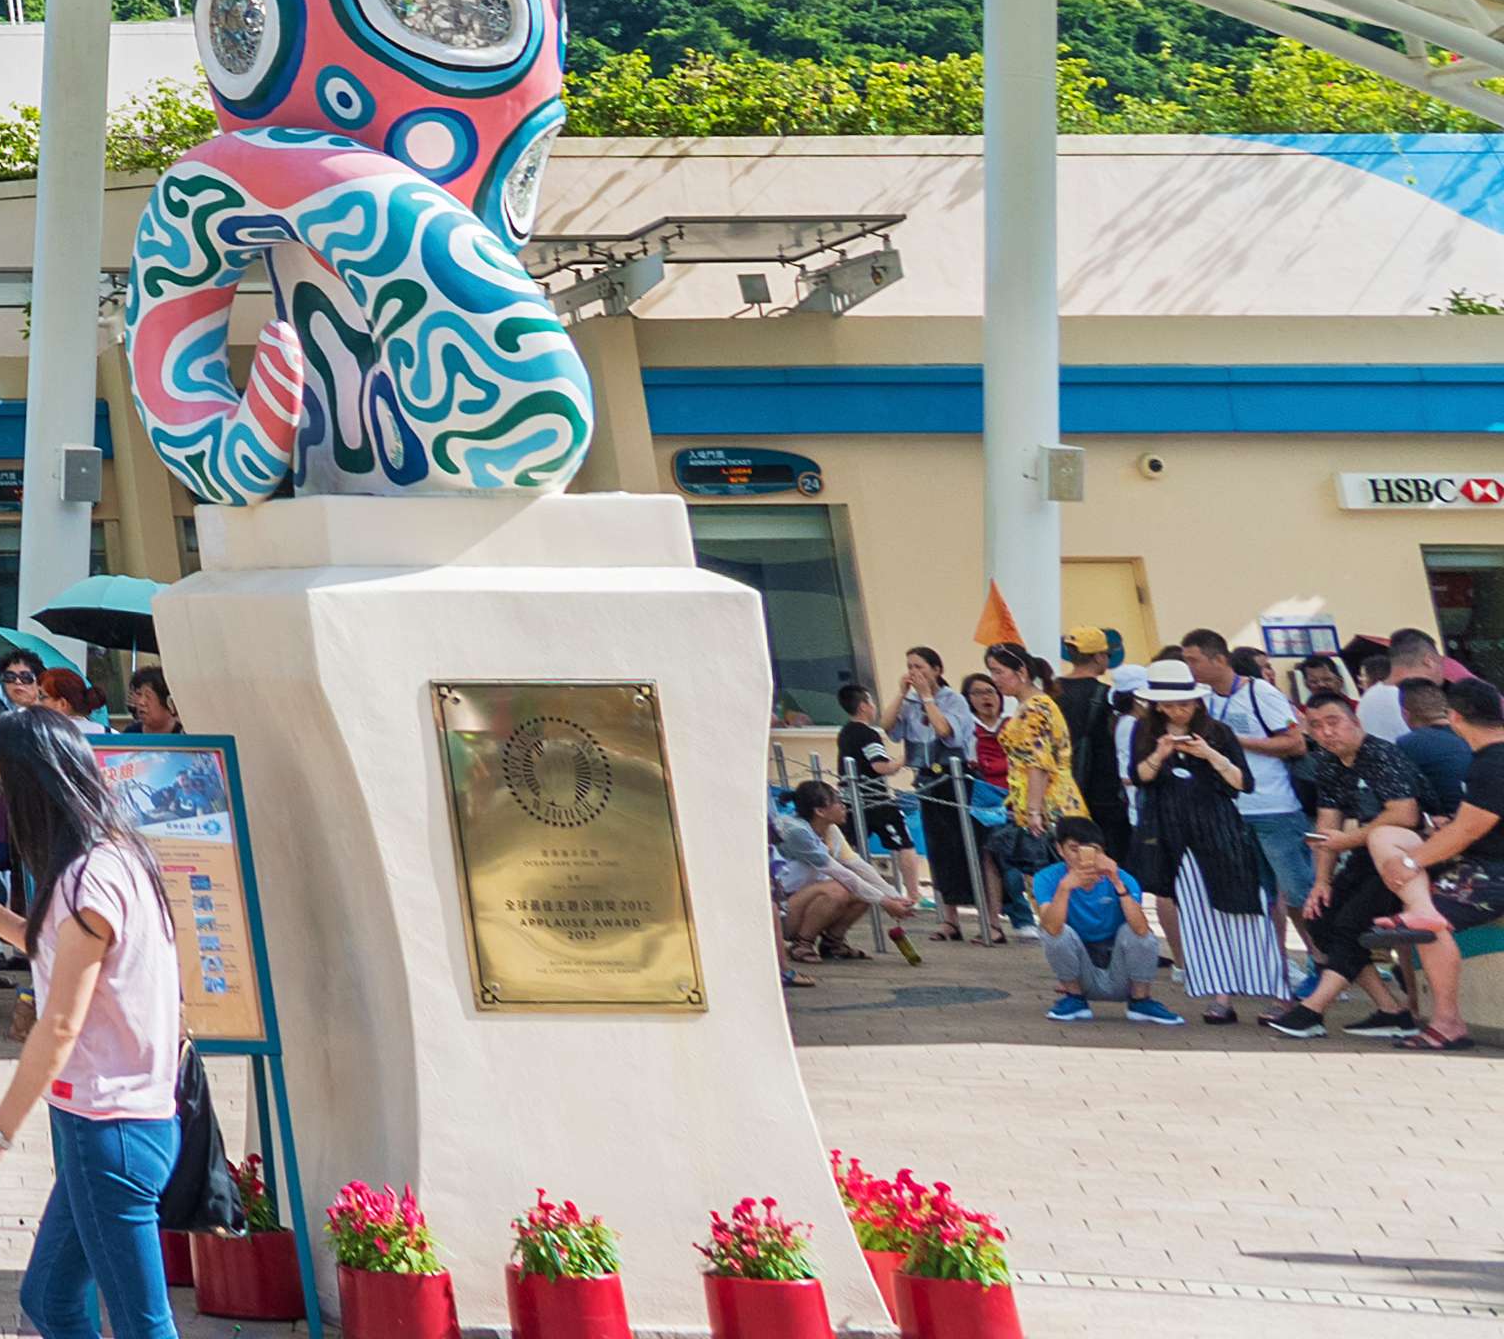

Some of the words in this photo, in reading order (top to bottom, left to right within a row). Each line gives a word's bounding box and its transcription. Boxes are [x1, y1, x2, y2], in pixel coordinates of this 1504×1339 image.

[802, 478, 820, 491] 24
[1368, 478, 1458, 503] HSBC
[621, 901, 652, 912] 2012
[520, 919, 587, 929] APPLAUSE
[593, 919, 641, 928] AWARD
[567, 930, 597, 940] 2012
